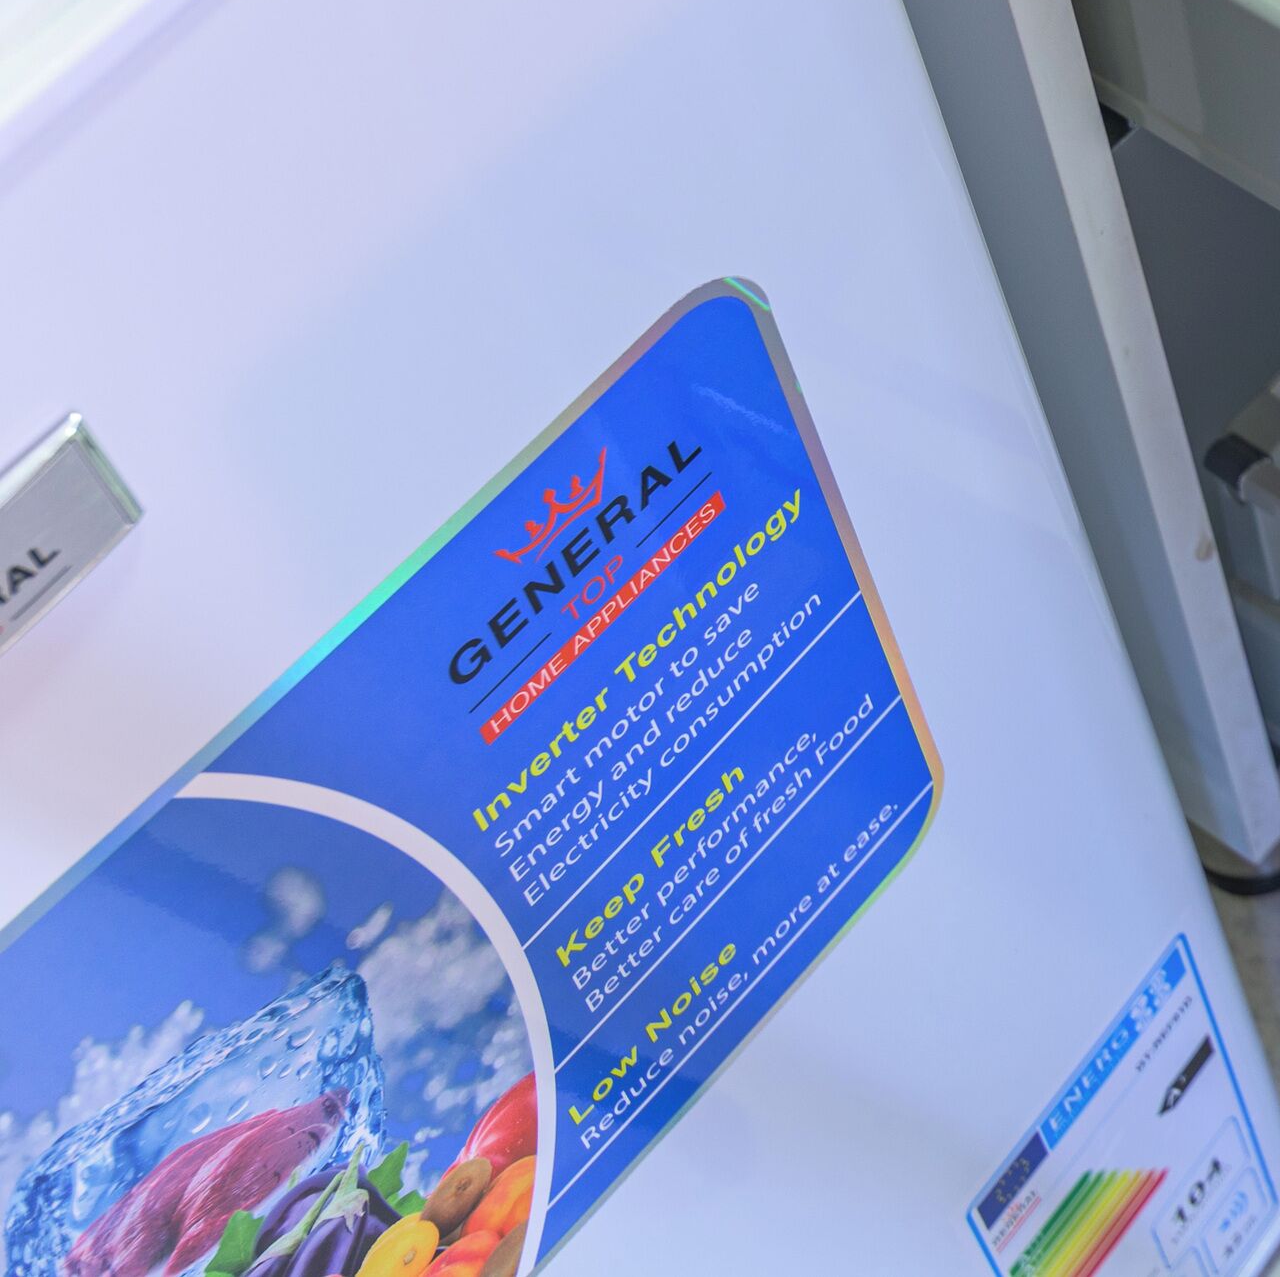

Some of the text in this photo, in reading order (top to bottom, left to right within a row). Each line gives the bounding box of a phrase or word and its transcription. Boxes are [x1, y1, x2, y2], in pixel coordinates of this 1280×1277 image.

[448, 441, 702, 684] GENERAL
[472, 489, 802, 831] Inverter Technology
[489, 502, 717, 735] HOME APPLIANCES
[561, 555, 624, 620] TOP
[494, 583, 760, 858] Smart motor to save
[508, 628, 752, 882] Energy and reduce
[523, 593, 822, 907] Electricity consumption
[555, 766, 745, 968] Keep Fresh
[571, 731, 817, 990] Better performance,
[580, 801, 899, 1150] Reduce noise, more at ease.
[585, 693, 875, 1013] Better care of fresh Food
[567, 941, 738, 1125] Low Noise
[1050, 1028, 1129, 1134] ENERG
